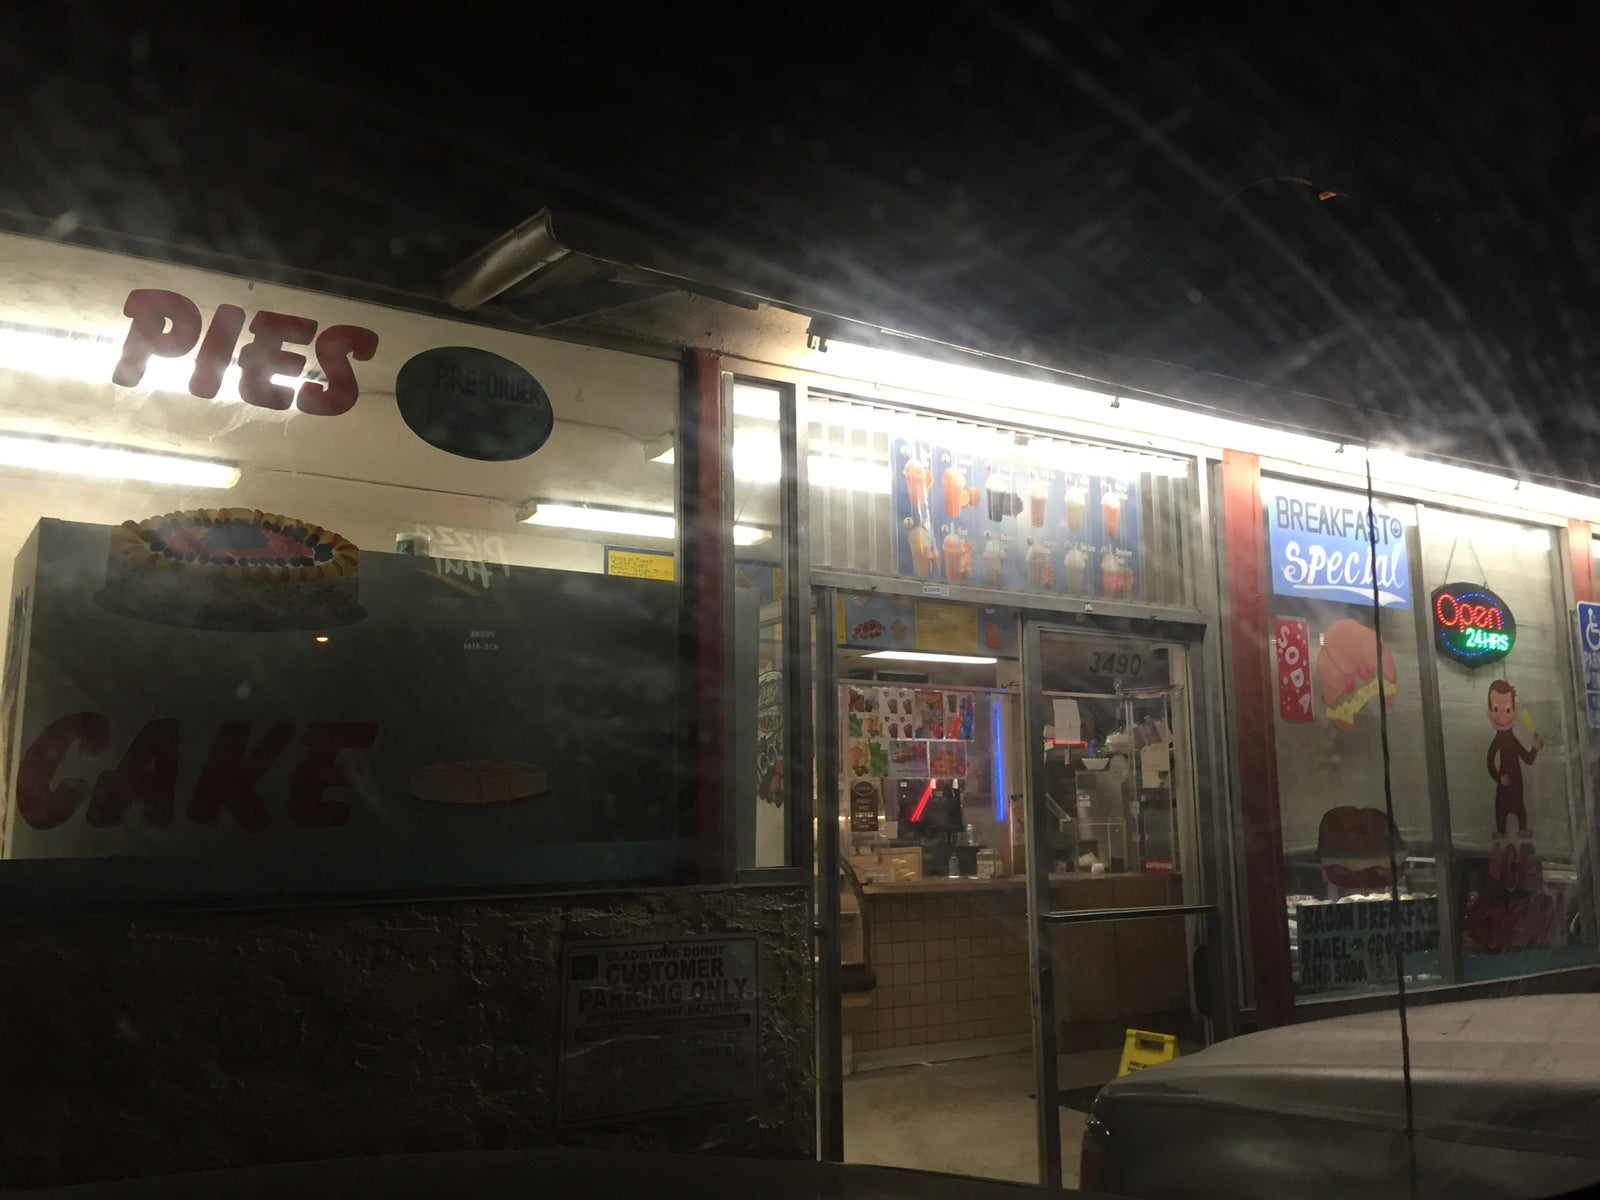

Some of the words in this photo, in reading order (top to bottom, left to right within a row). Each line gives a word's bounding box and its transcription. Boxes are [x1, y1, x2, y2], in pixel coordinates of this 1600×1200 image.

[111, 288, 379, 416] PIES
[434, 361, 543, 406] PRE-ORDER
[1276, 495, 1391, 545] BREAKFAST
[1436, 593, 1502, 633] Open
[1465, 627, 1510, 652] 24HRS
[1089, 651, 1142, 676] 3490
[1278, 625, 1313, 714] SODA
[17, 711, 380, 833] CAKE
[1303, 903, 1354, 934] BACON
[605, 947, 680, 963] GLADSTONE
[683, 945, 726, 958] DONUT
[1302, 936, 1351, 964] BAGEL
[1368, 930, 1441, 957] CROSANT
[605, 957, 725, 985] CUSTOMER
[578, 982, 683, 1012] PARKING
[689, 977, 748, 1001] ONLY
